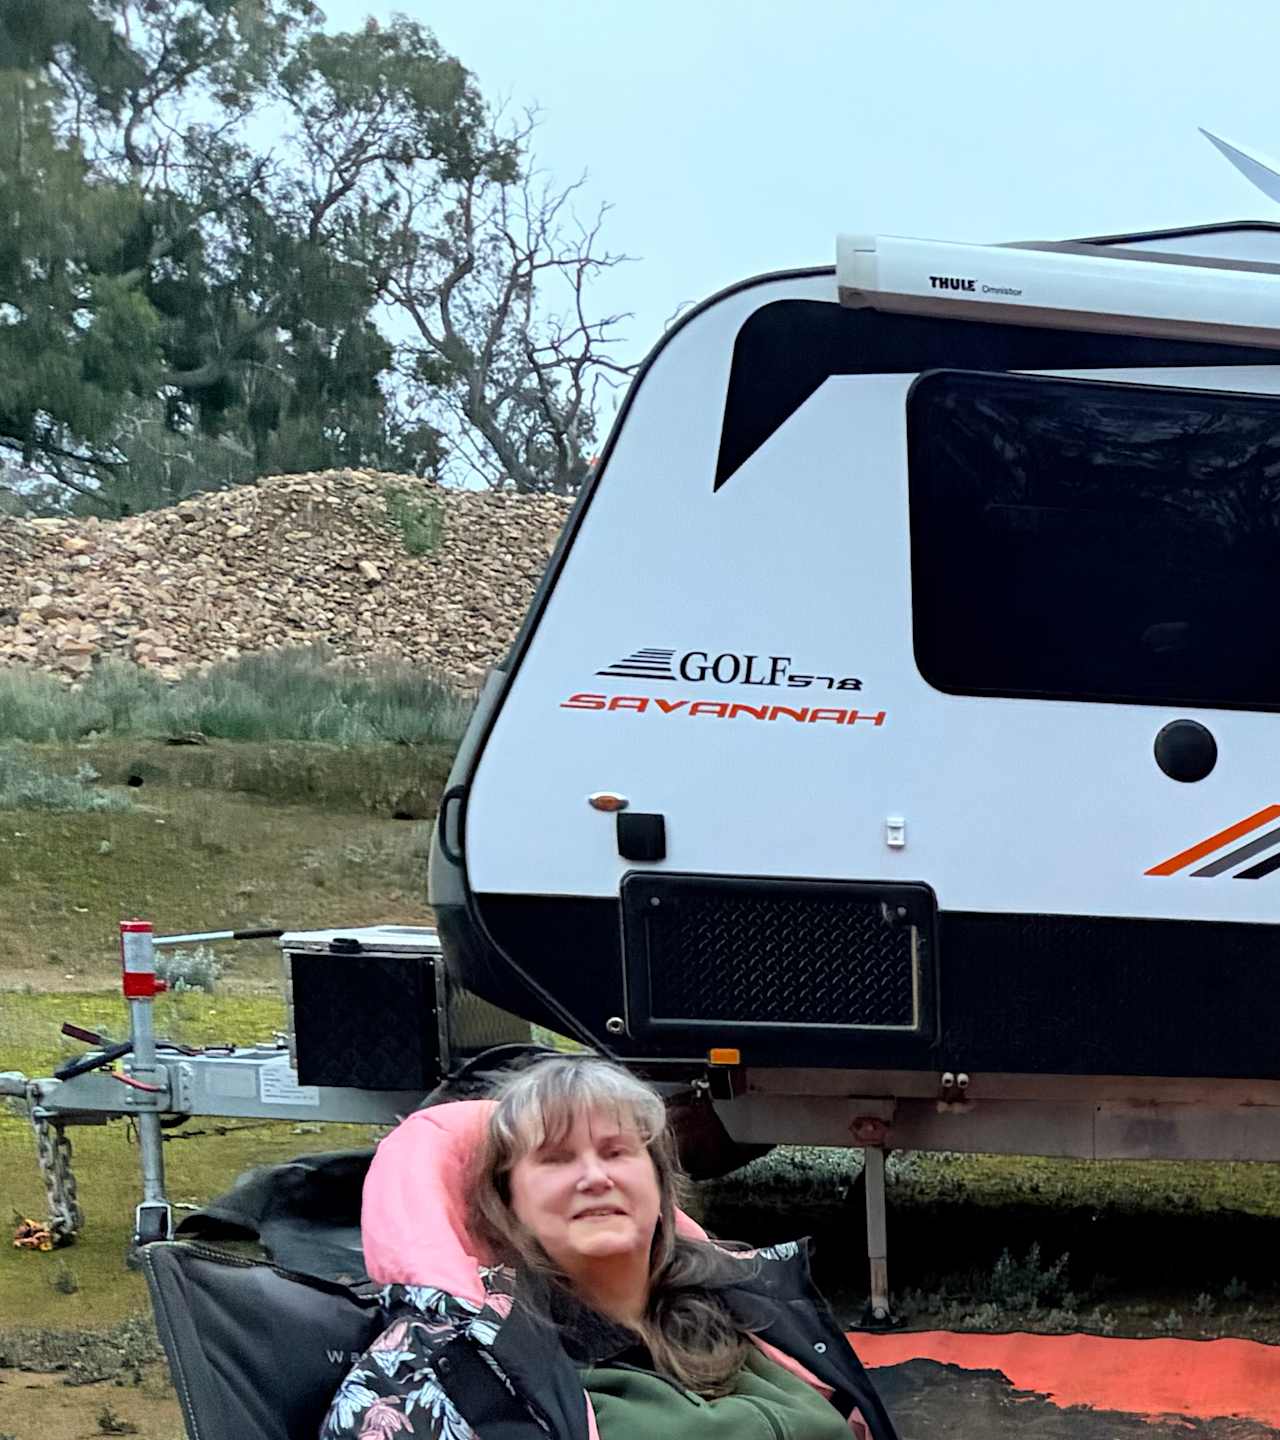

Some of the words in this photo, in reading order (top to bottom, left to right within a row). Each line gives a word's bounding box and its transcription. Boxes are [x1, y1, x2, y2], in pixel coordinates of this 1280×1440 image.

[929, 276, 976, 292] THULE
[679, 651, 791, 687] GOLF
[787, 674, 864, 692] 578
[559, 693, 887, 727] SAVANNAH
